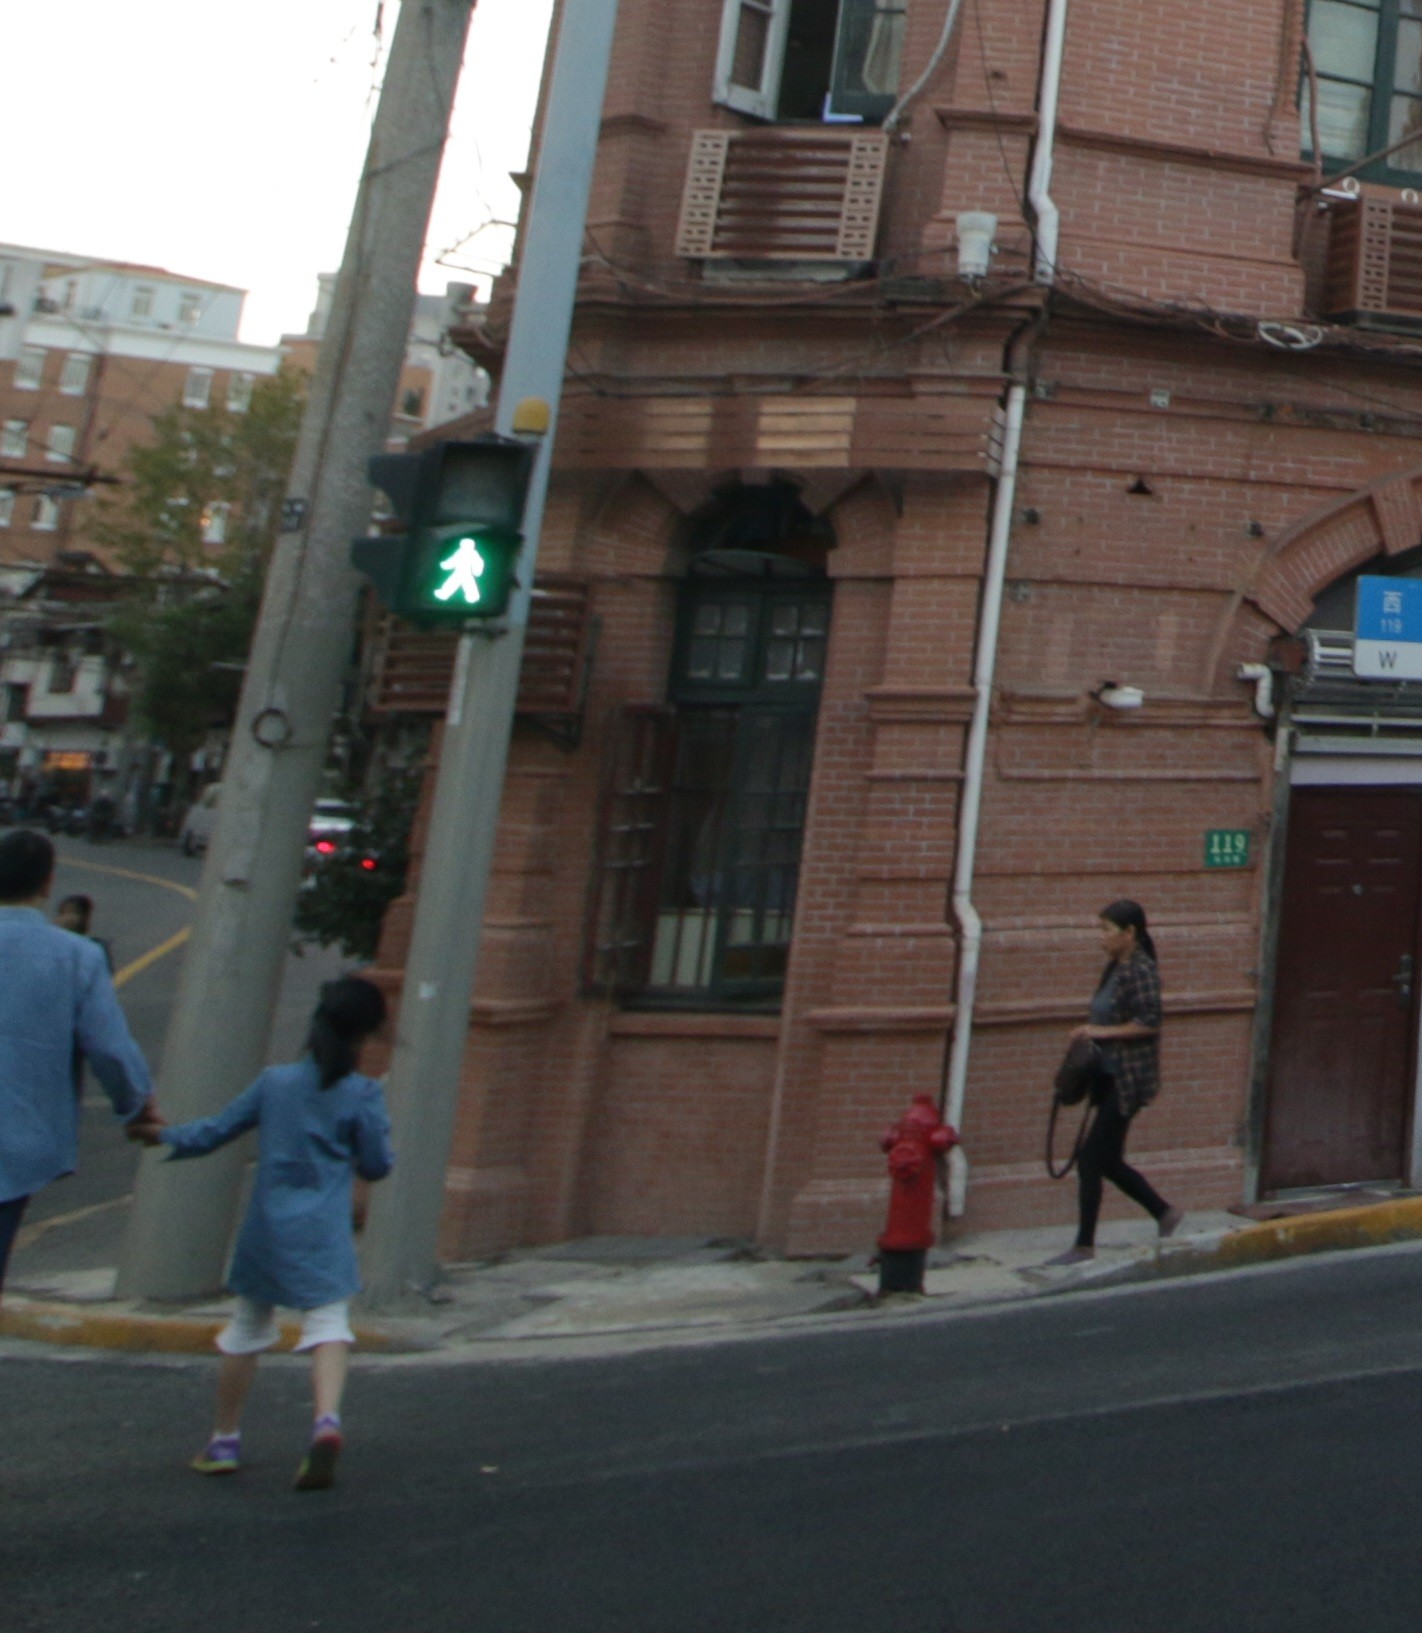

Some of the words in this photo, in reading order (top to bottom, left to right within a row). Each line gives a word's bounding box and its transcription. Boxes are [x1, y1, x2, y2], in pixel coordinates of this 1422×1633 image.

[1382, 590, 1404, 614] 西
[1378, 650, 1398, 670] W
[1210, 833, 1246, 854] 119
